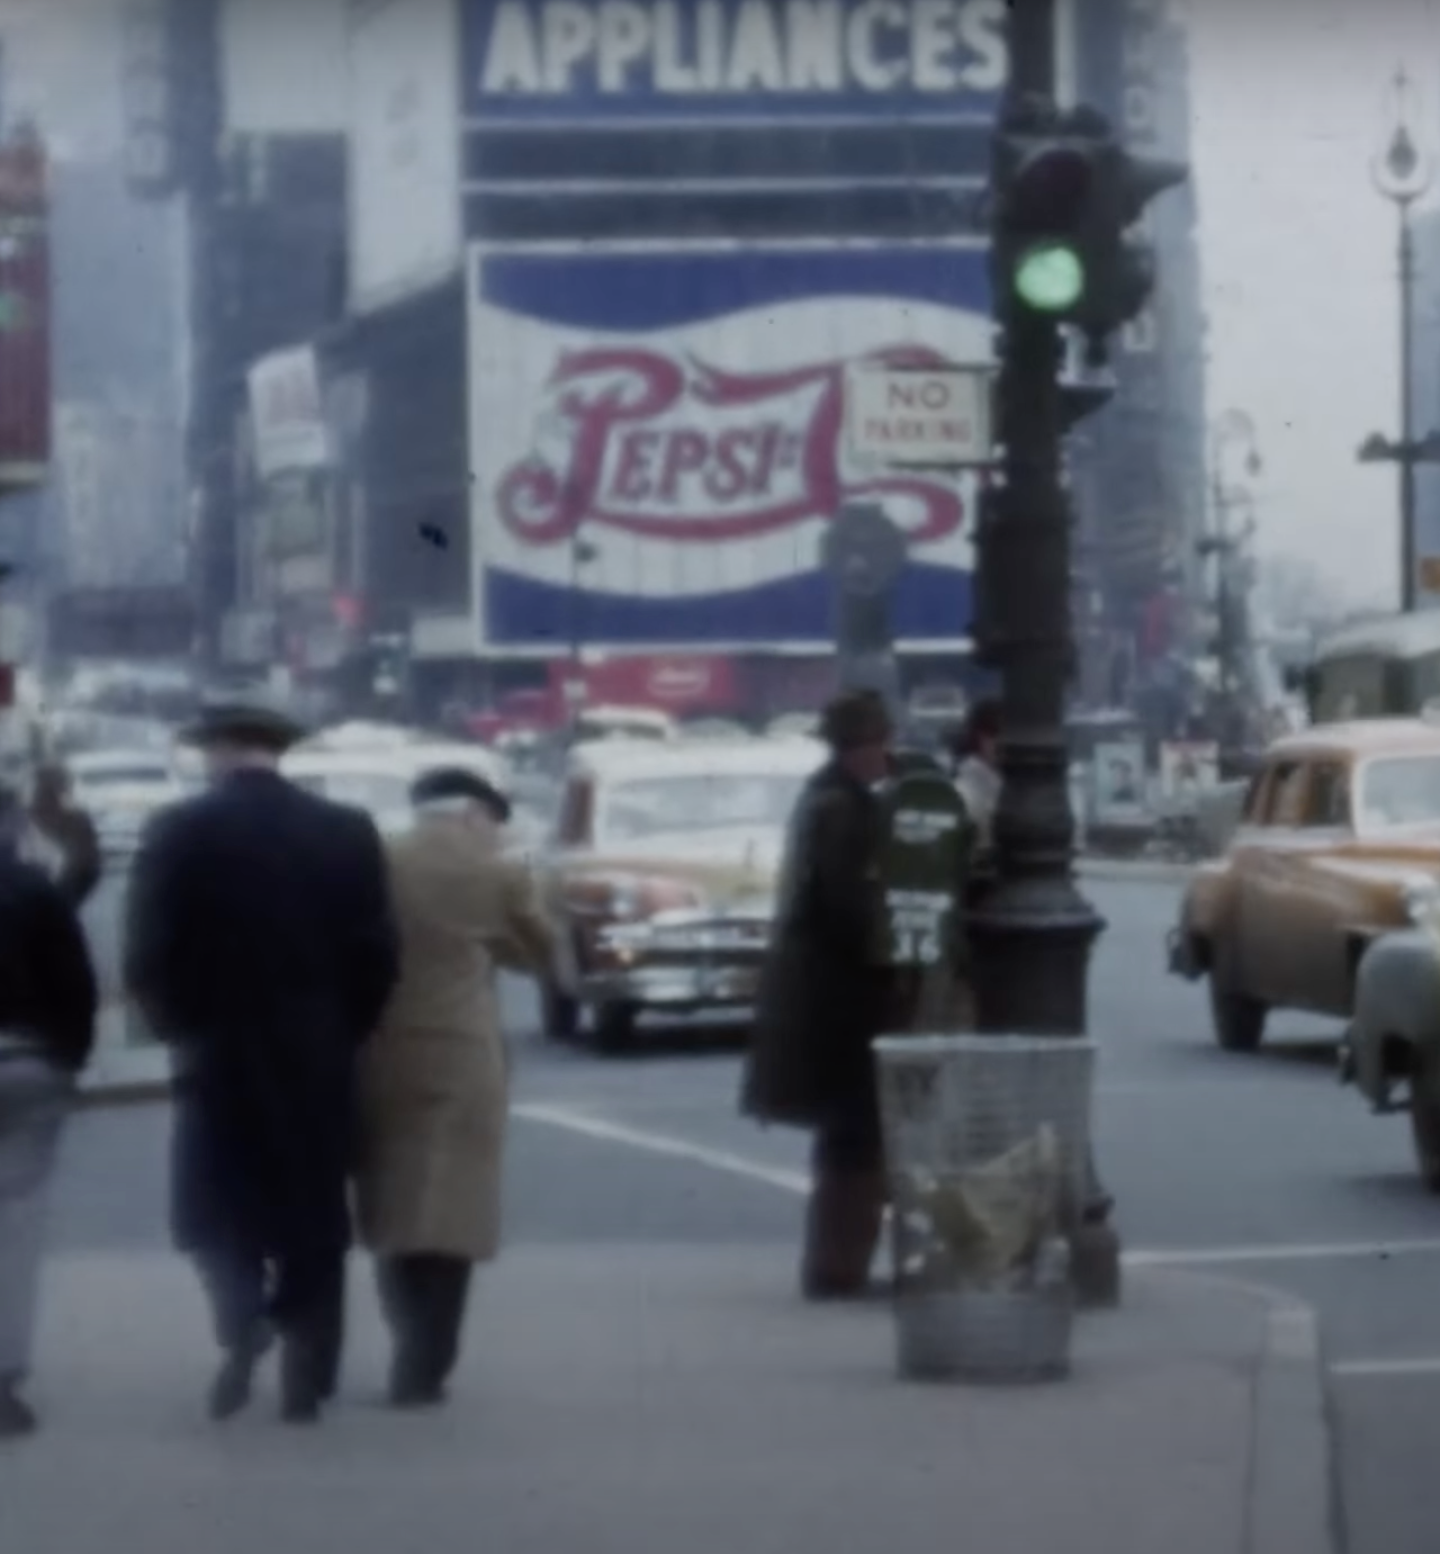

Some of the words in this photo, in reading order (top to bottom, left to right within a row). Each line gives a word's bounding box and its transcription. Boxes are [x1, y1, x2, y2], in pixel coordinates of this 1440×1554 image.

[482, 1, 1008, 91] APPLIANCES
[888, 380, 950, 411] NO
[864, 418, 972, 441] PARKING
